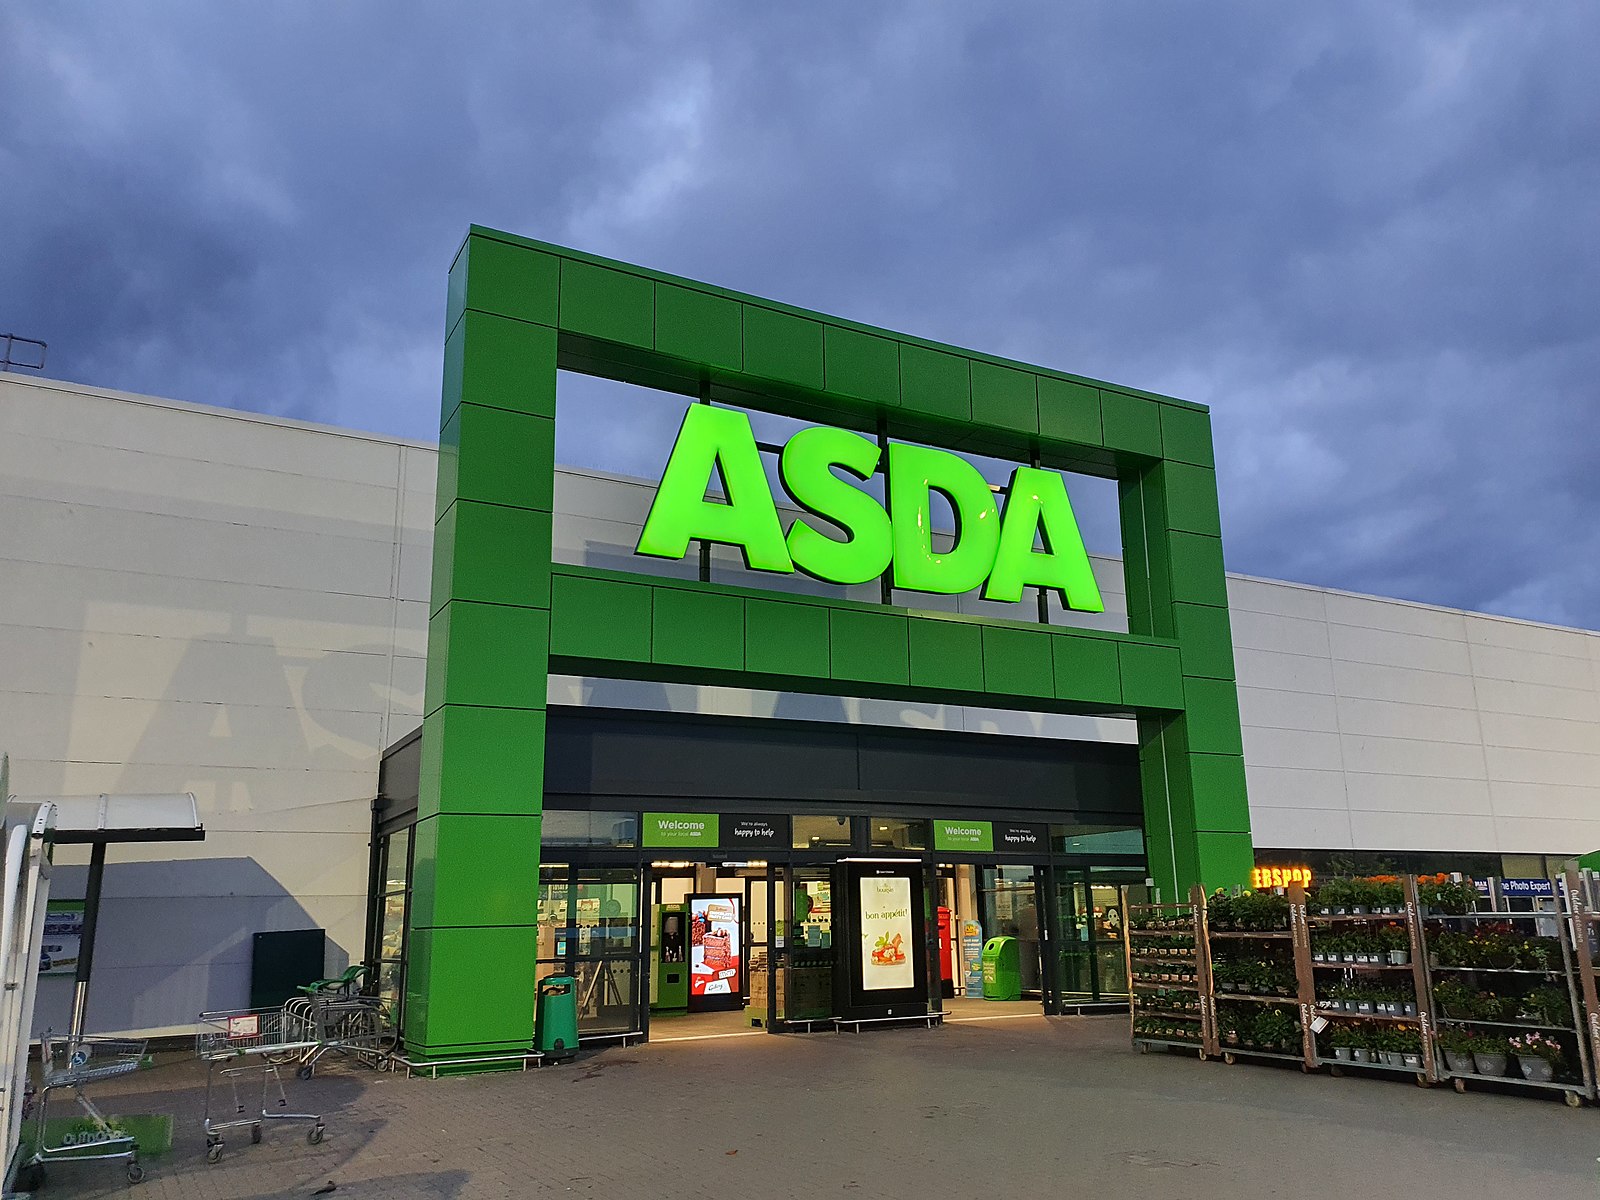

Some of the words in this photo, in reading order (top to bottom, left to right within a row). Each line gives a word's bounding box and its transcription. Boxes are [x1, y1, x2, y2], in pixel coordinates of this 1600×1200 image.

[634, 402, 1104, 612] ASDA
[658, 820, 705, 829] Welcome
[734, 828, 753, 837] happy
[754, 828, 761, 836] to
[761, 828, 774, 837] help
[944, 826, 982, 836] Welcome
[1004, 834, 1020, 843] happy
[1020, 834, 1026, 842] to
[1026, 834, 1037, 843] help
[1510, 881, 1529, 890] Photo
[1530, 881, 1551, 892] Expert
[1570, 889, 1582, 915] Outdoor
[865, 911, 880, 919] bon
[1406, 902, 1415, 925] Outdoor
